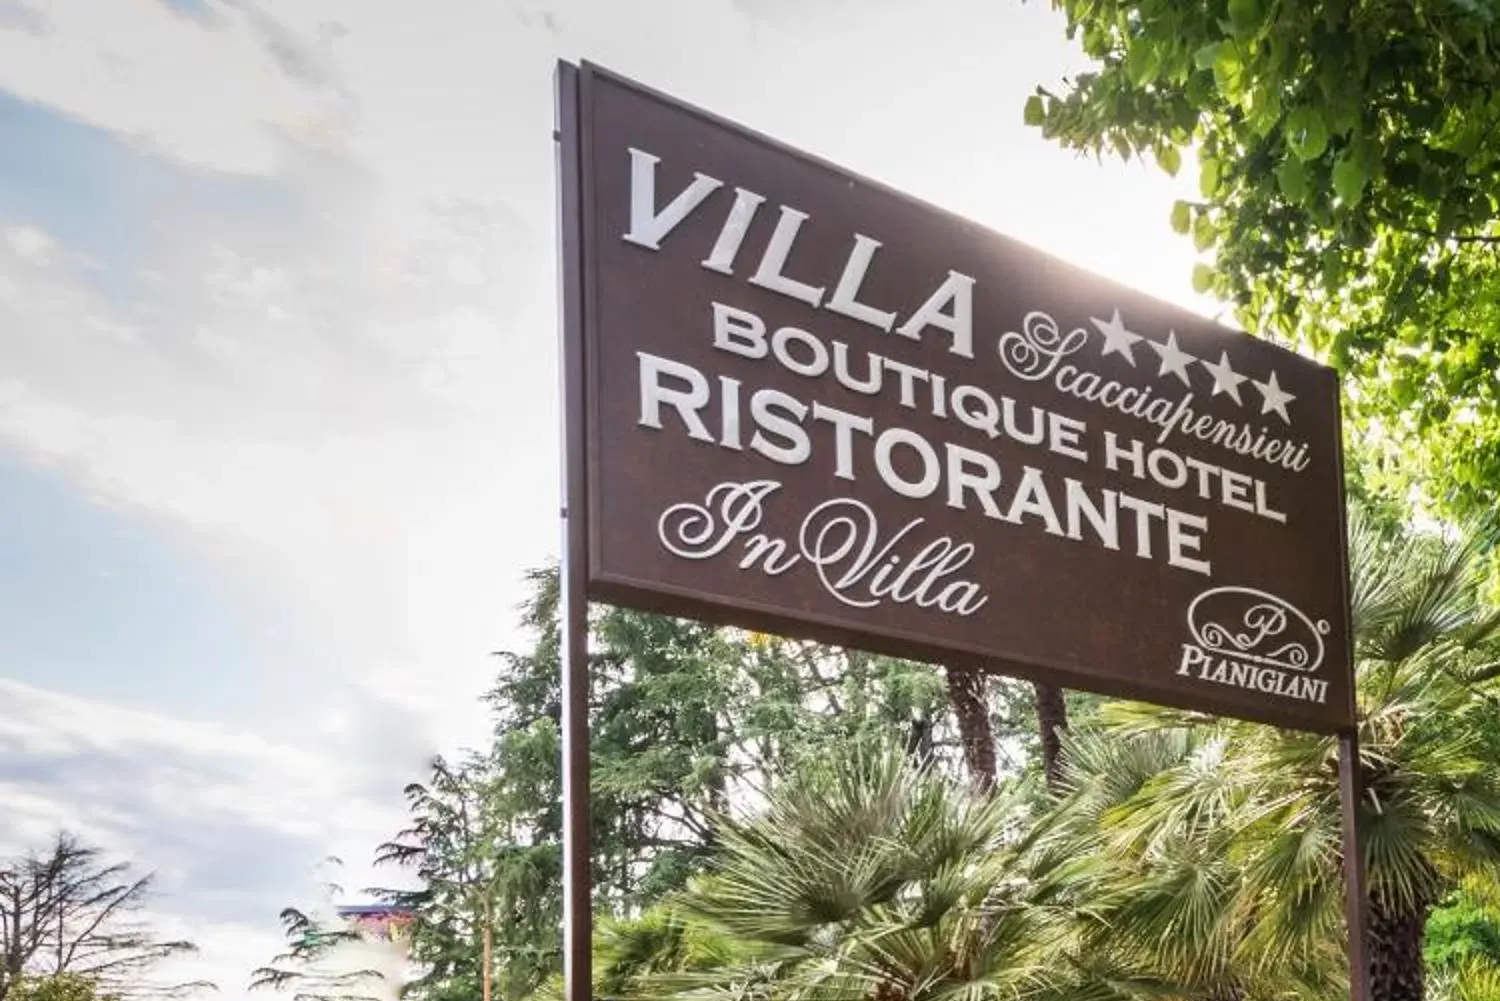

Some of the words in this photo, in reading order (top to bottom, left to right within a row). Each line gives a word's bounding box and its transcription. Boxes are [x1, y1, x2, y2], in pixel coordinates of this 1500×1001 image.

[622, 147, 976, 358] VILLA
[999, 311, 1311, 473] Scacciapensieri
[711, 302, 1087, 462] BOUTIQUE
[1104, 431, 1287, 522] HOTEL
[636, 351, 1211, 575] RISTORANTE
[658, 480, 801, 576] In
[799, 497, 988, 616] Villa
[1176, 643, 1329, 704] PIANIGIANI
